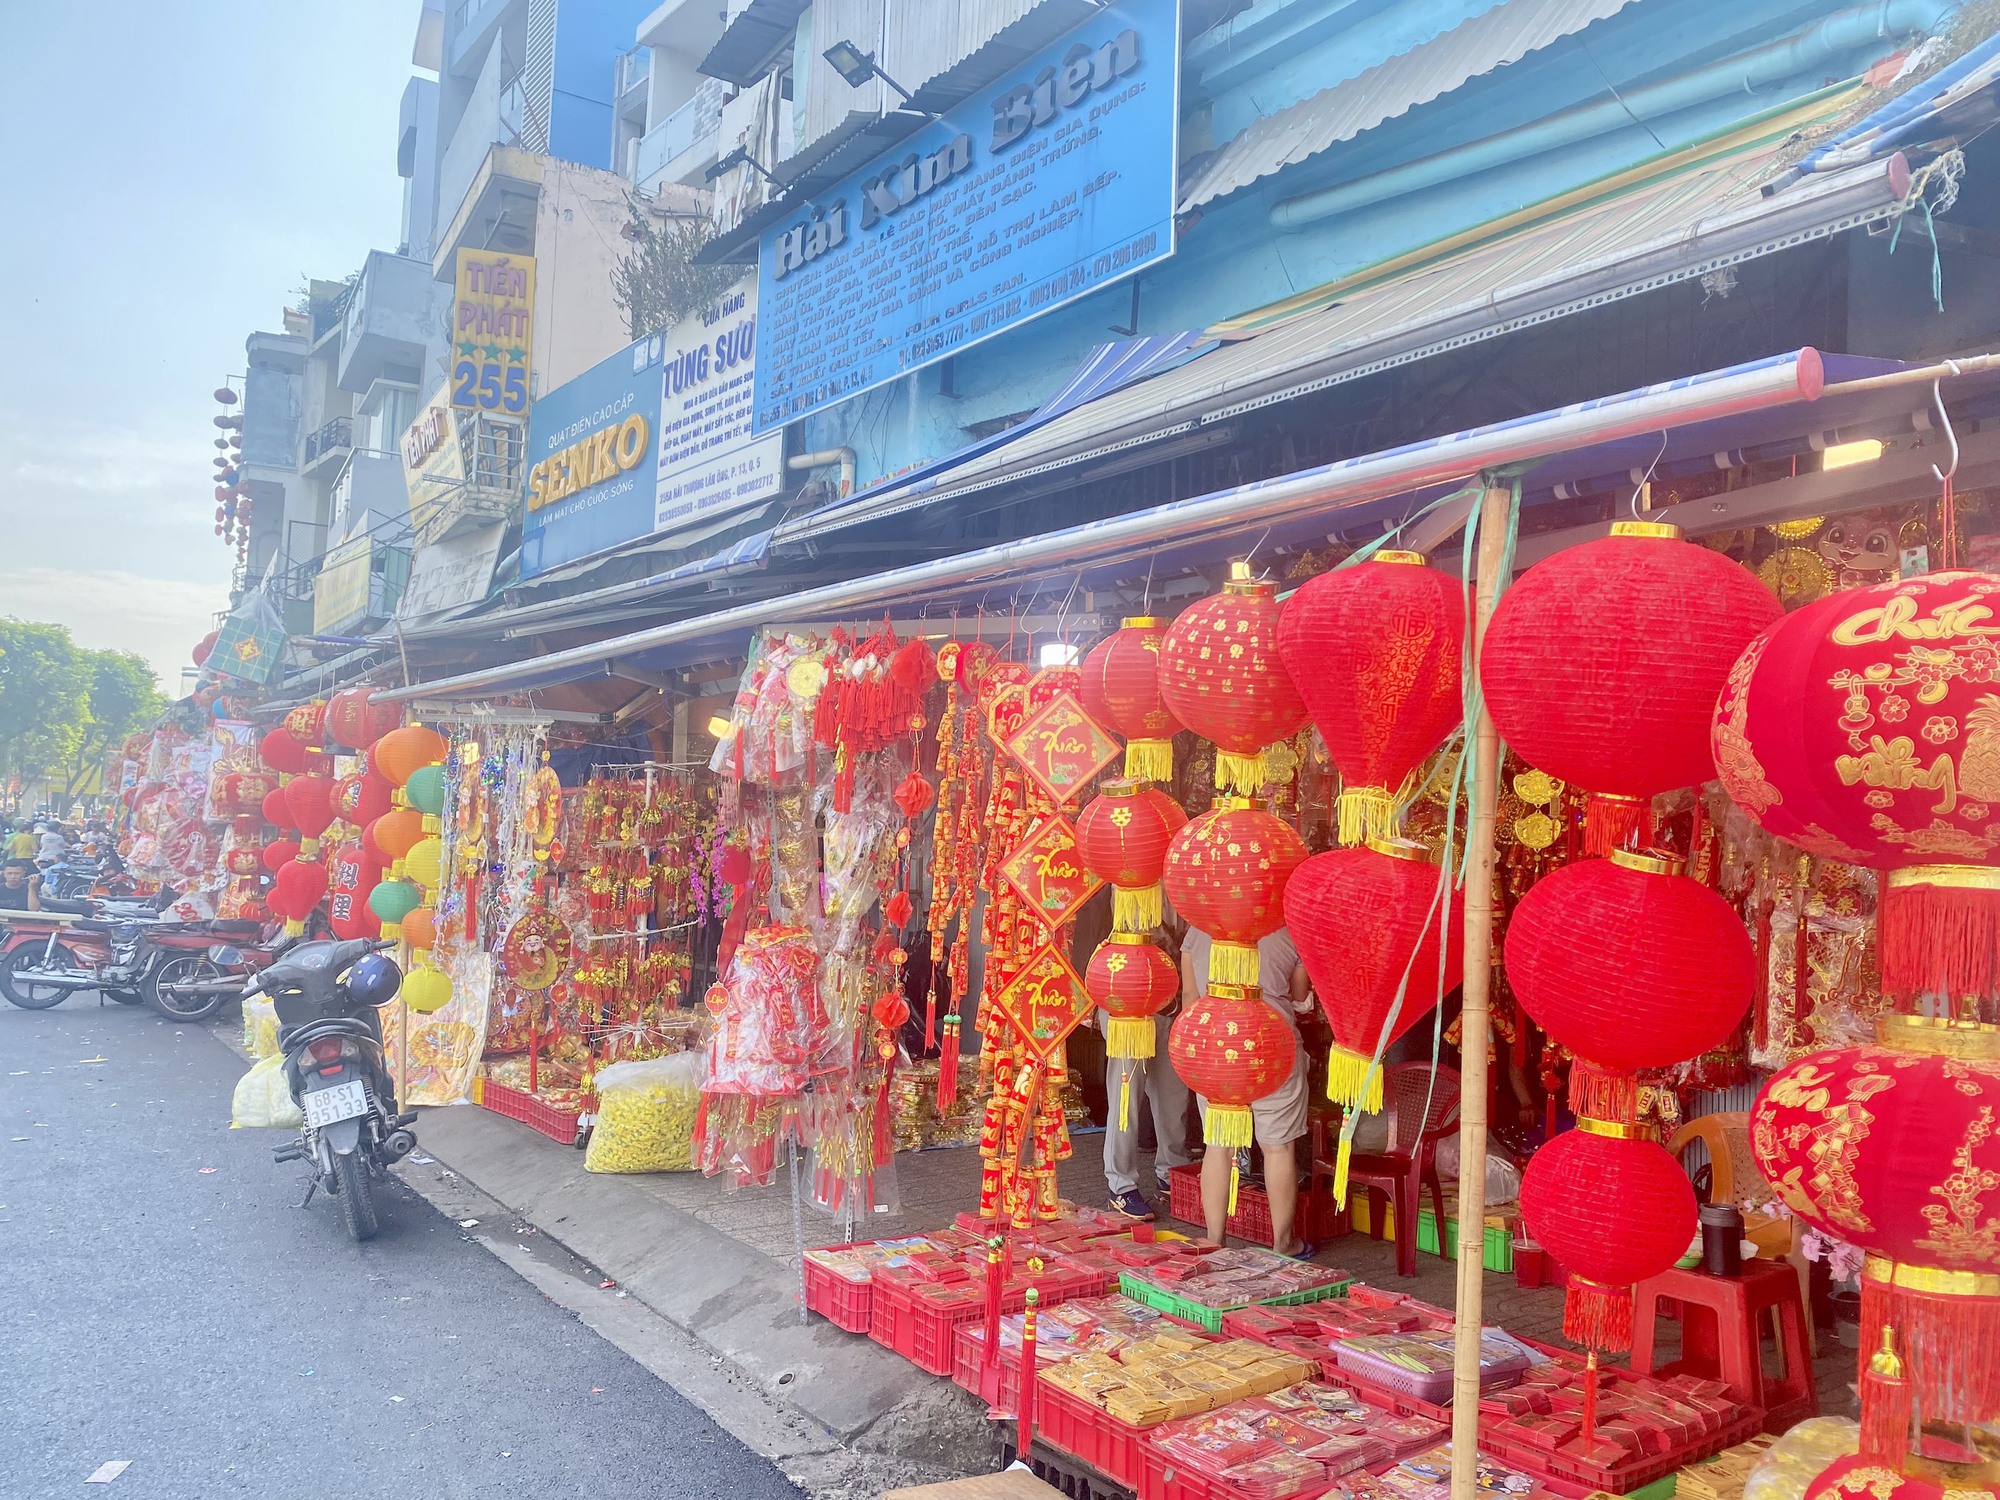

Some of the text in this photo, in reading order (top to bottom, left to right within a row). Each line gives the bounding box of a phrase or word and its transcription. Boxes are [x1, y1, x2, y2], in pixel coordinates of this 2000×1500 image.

[773, 28, 1140, 282] Hải Kim Biên
[774, 271, 821, 301] CHUYÊN:
[824, 253, 848, 273] BÁN
[867, 239, 876, 250] &
[899, 210, 924, 231] CÁC
[929, 190, 958, 216] MẶT
[963, 164, 1004, 194] HÀNG
[1010, 138, 1047, 167] ĐIỆN
[1053, 118, 1082, 141] GIA
[1088, 83, 1145, 122] DỤNG:
[1039, 192, 1076, 219] LÀM
[859, 246, 887, 268] MÁY
[891, 227, 922, 251] SINH
[953, 191, 985, 217] MÁY
[991, 163, 1034, 195] ĐÁNH
[817, 287, 839, 306] BẾP
[867, 257, 894, 279] MÁY
[898, 240, 925, 262] SẤY
[965, 202, 995, 226] ĐÈN
[1001, 182, 1036, 206] SẠC.
[467, 257, 527, 299] TIẾN
[867, 269, 901, 293] TÙNG
[905, 248, 939, 273] THAY
[459, 301, 529, 338] PHÁT
[723, 291, 745, 318] HÀNG
[772, 354, 792, 370] CÁC
[825, 325, 850, 344] MÁY
[853, 310, 877, 330] XAY
[881, 300, 903, 316] GIA
[945, 268, 963, 284] VÀ
[969, 244, 1011, 272] CÔNG
[905, 315, 940, 337] FOUR
[945, 292, 986, 318] GIRLS
[992, 273, 1026, 295] FAN.
[853, 328, 874, 346] TẾT
[453, 360, 527, 412] 255
[663, 343, 711, 400] TÙNG
[547, 427, 569, 449] QUẠT
[570, 416, 591, 437] ĐIỆN
[592, 404, 612, 424] CAO
[528, 413, 649, 512] SENKO
[731, 466, 736, 478] P.
[738, 462, 747, 475] 13,
[756, 457, 760, 468] 5
[569, 499, 585, 514] CHO
[1040, 725, 1086, 770] Xuân
[1033, 850, 1078, 895] Xuân
[1026, 978, 1067, 1023] Xuân
[311, 1099, 363, 1125] 351.33
